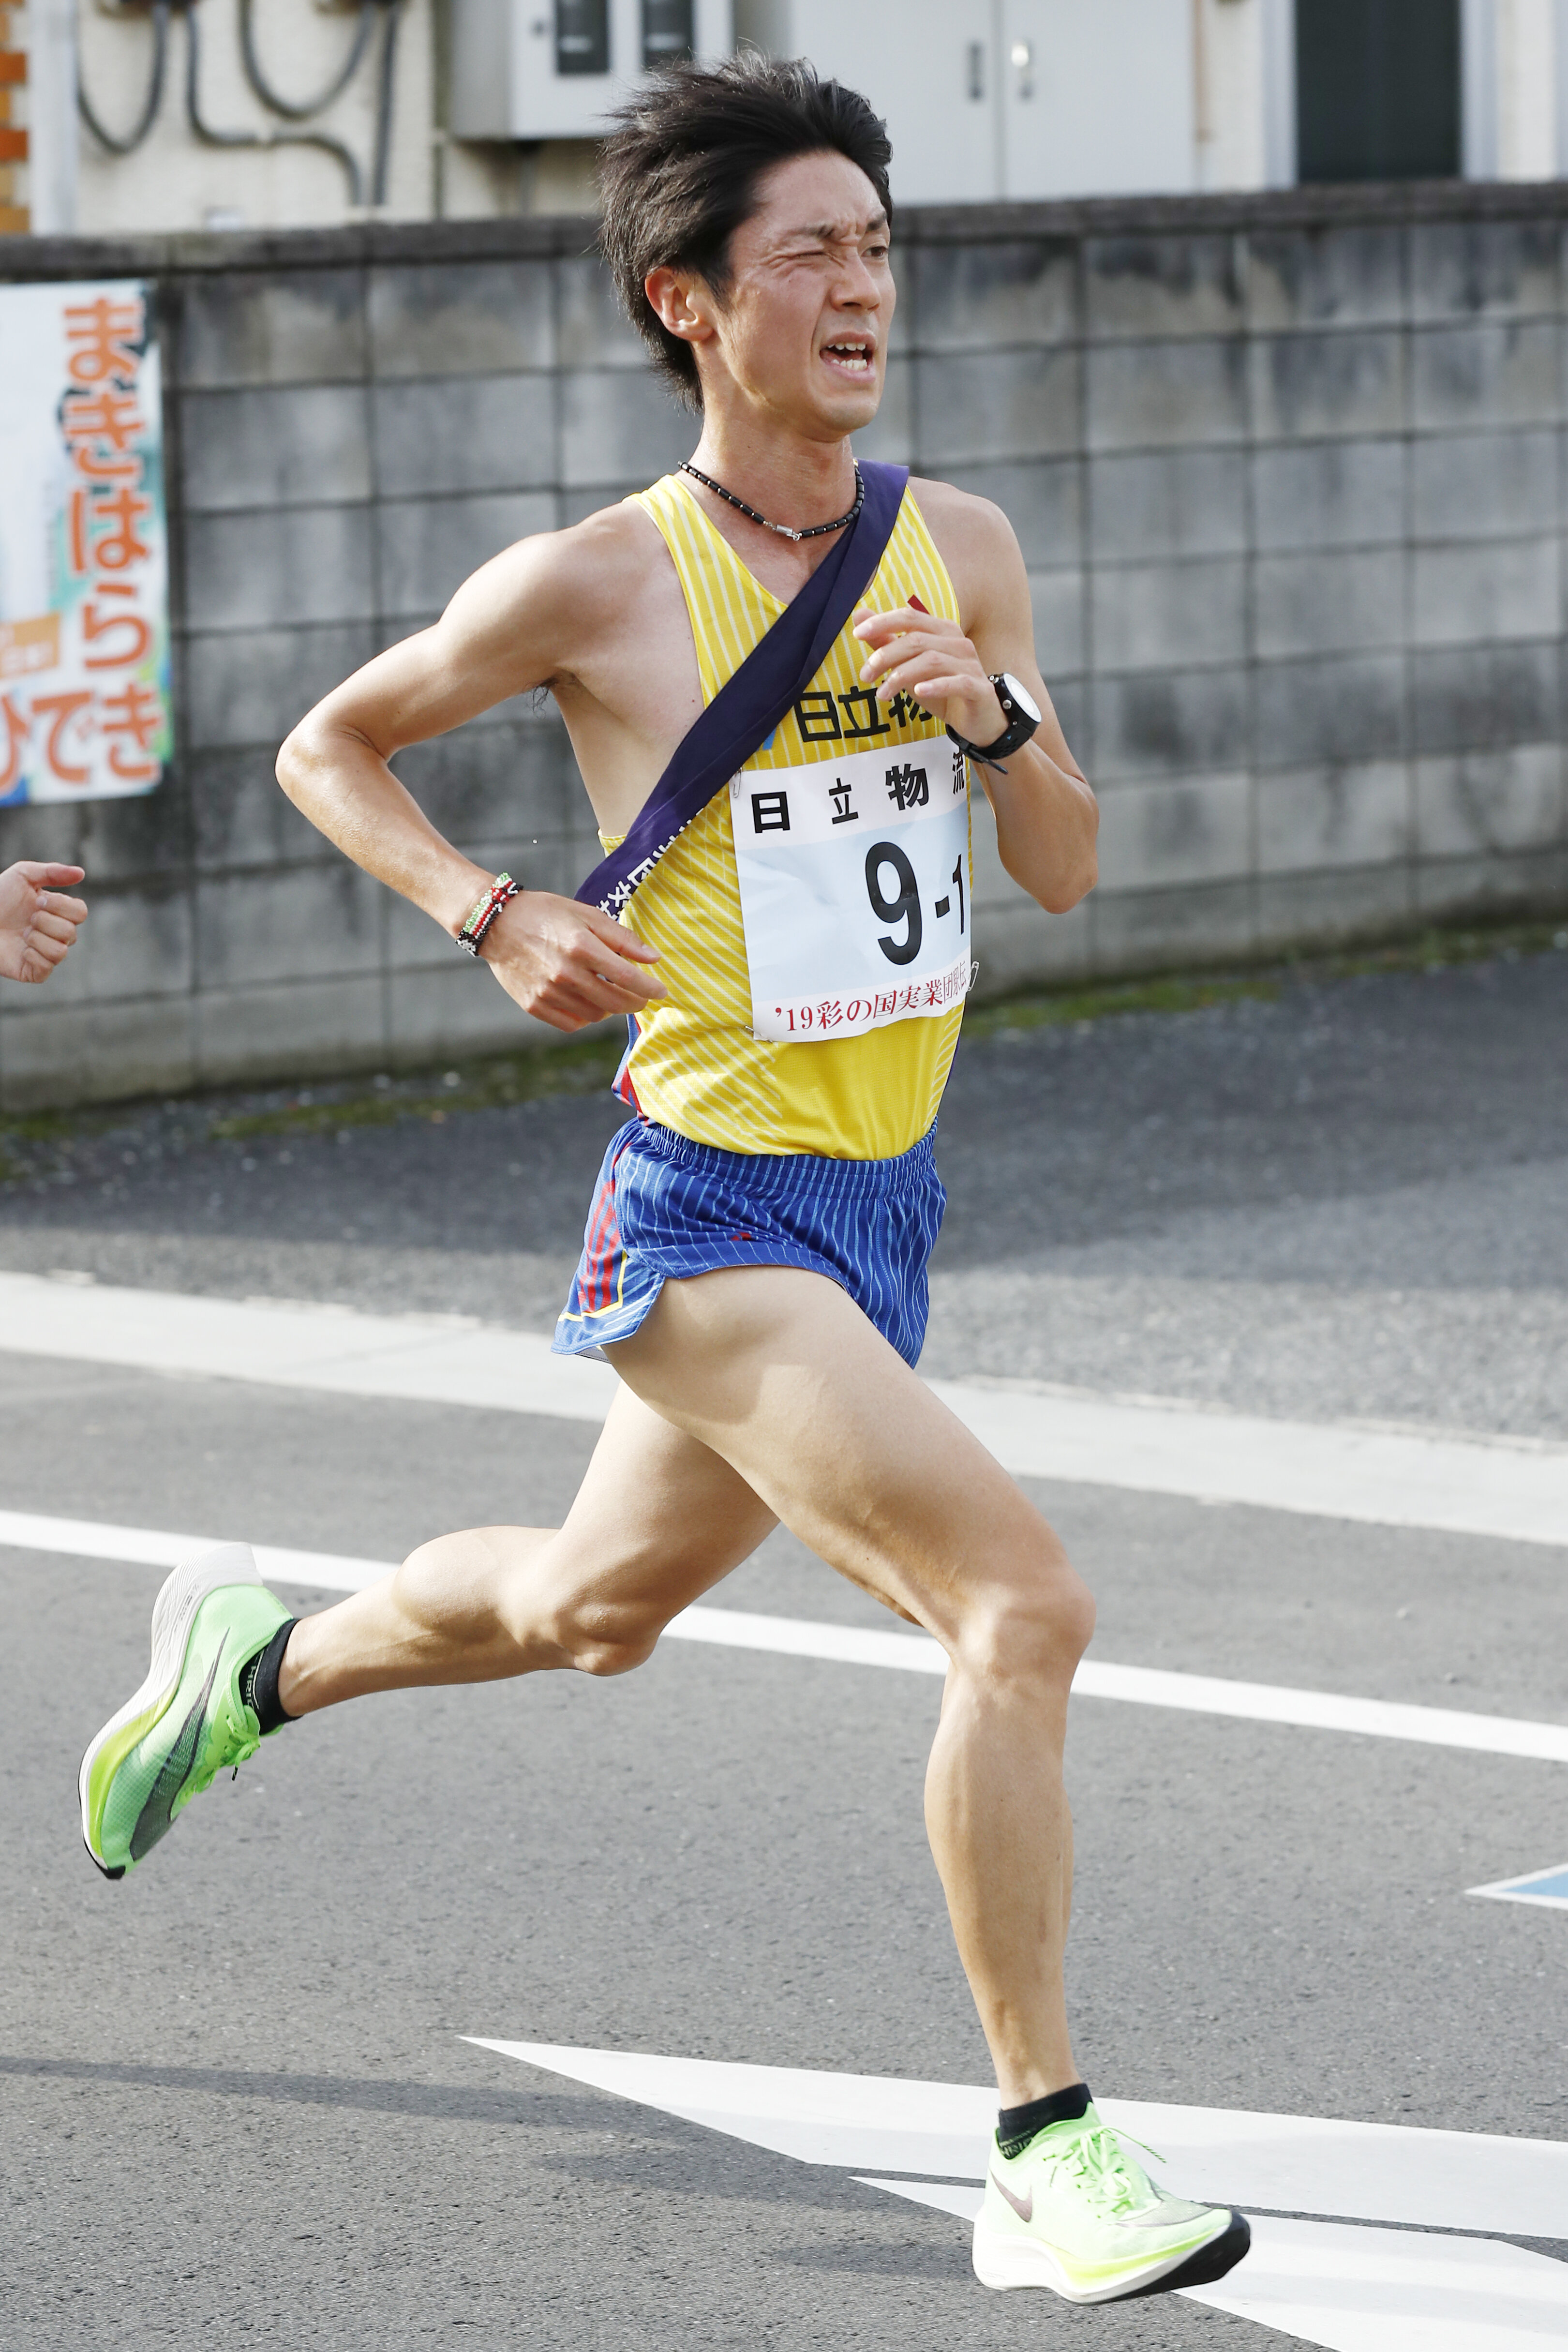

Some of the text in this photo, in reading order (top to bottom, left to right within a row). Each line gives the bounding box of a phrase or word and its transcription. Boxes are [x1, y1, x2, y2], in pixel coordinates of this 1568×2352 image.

[62, 296, 154, 672] まきはら
[751, 749, 965, 834] 日立物流
[865, 841, 964, 966] 9-1
